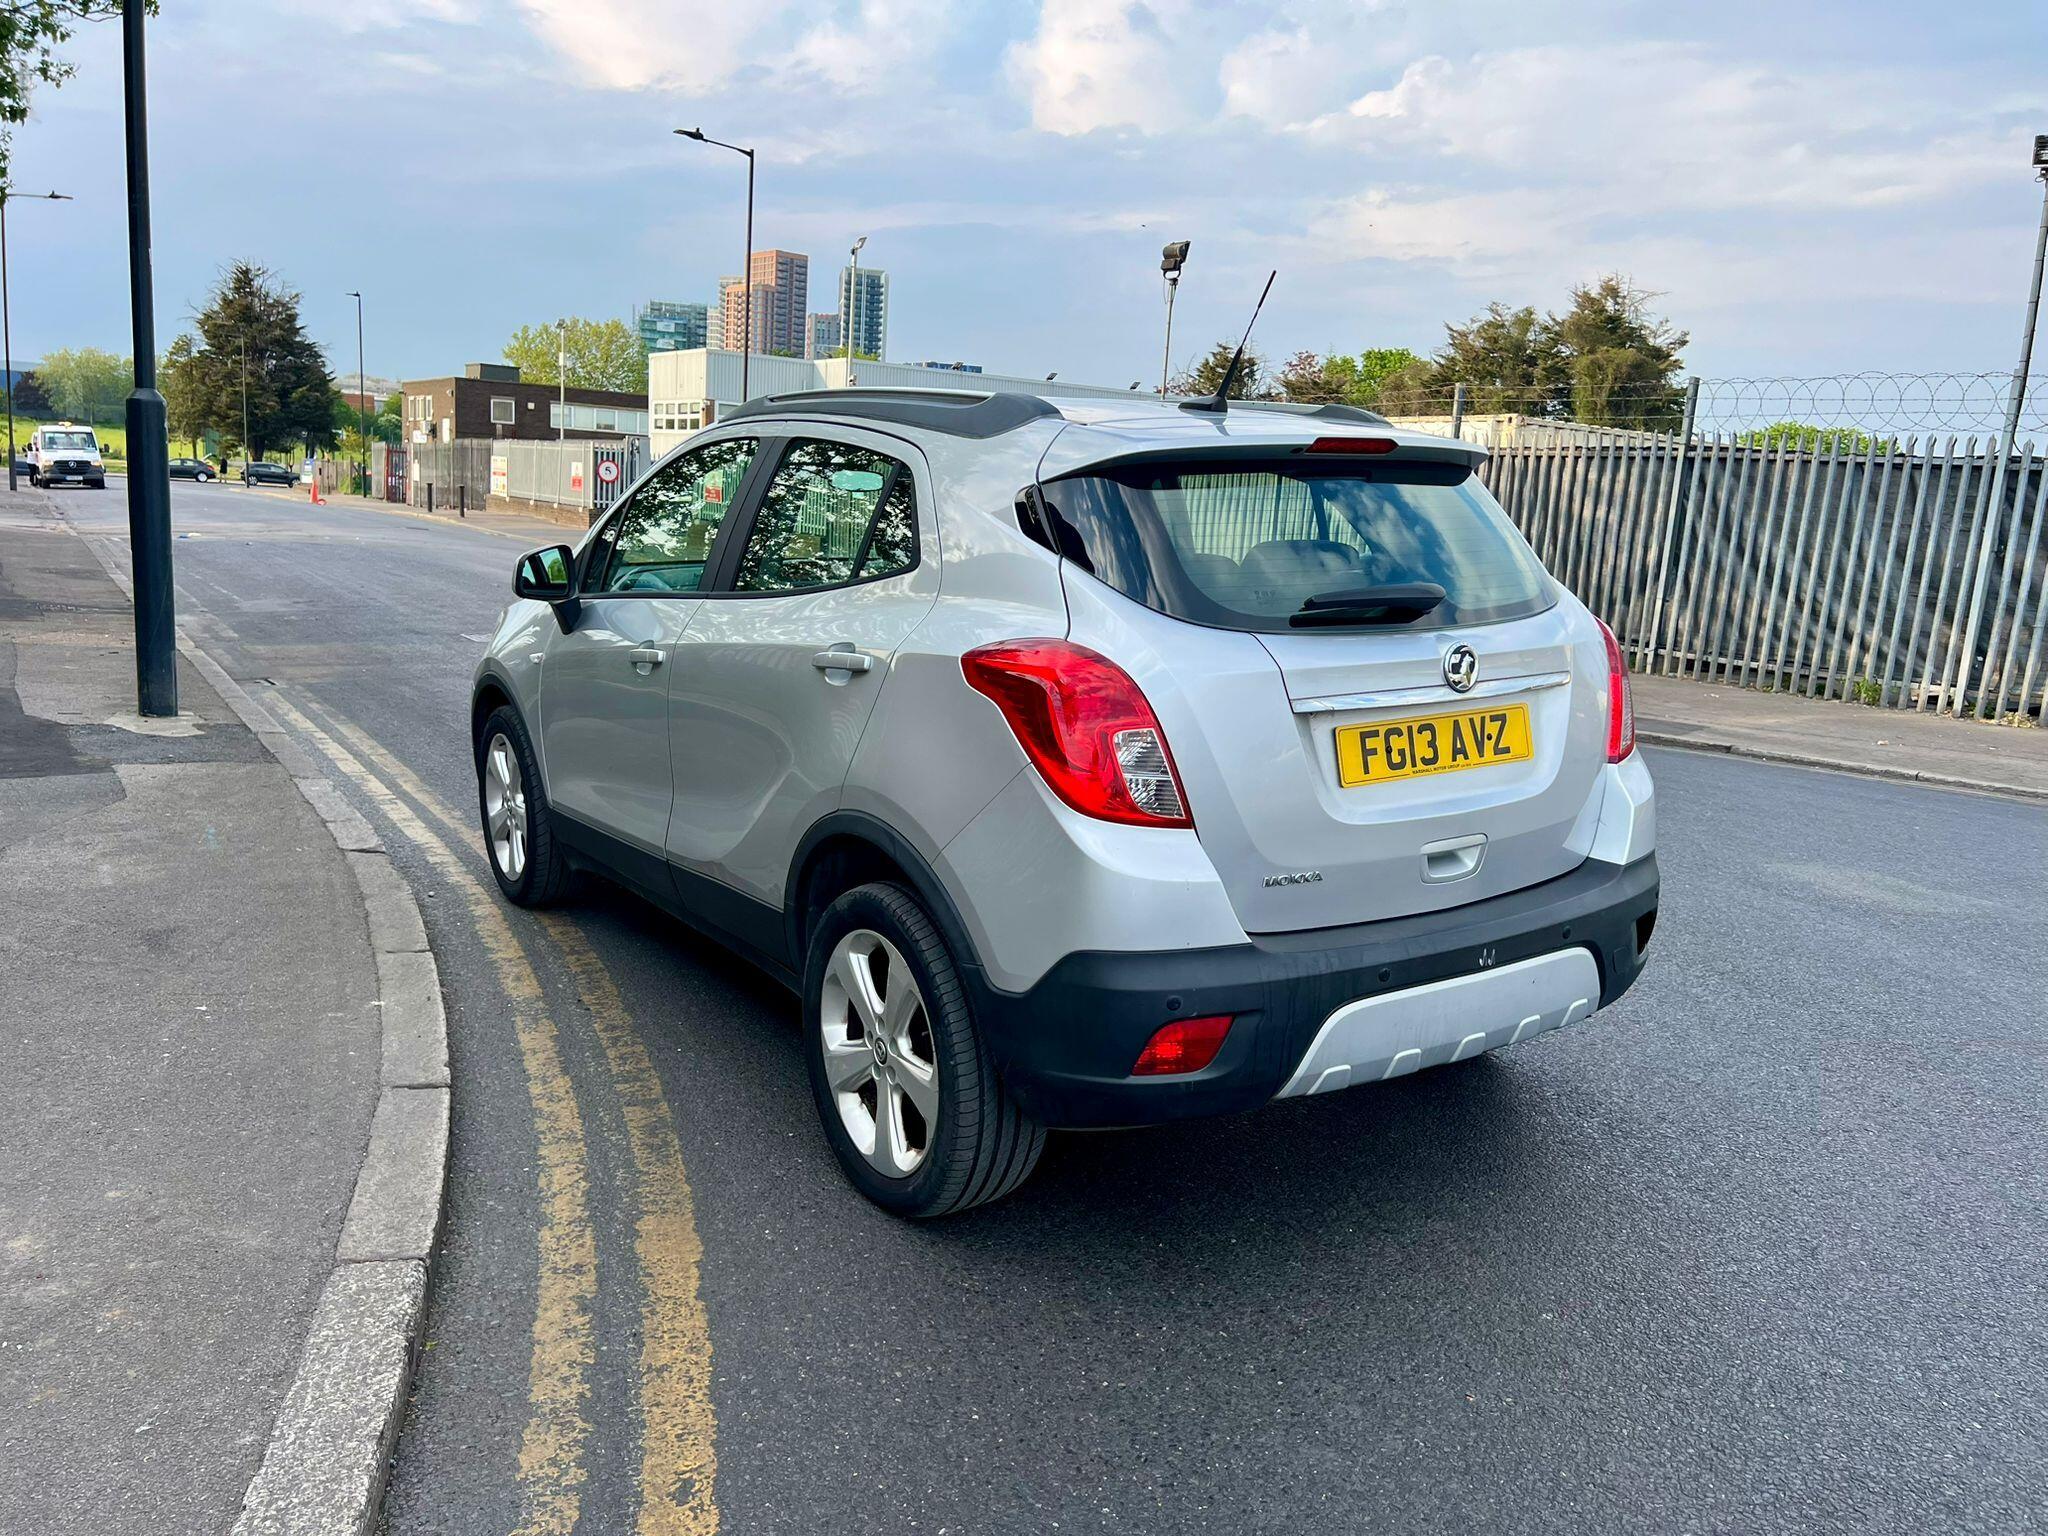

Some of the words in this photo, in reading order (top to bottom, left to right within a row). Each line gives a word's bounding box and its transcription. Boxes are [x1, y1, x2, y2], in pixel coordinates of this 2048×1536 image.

[604, 466, 612, 476] 5
[1359, 723, 1440, 775] FG13
[1451, 713, 1511, 763] AVZ
[1411, 767, 1433, 775] MARSHALL
[1262, 870, 1323, 888] MOKKA
